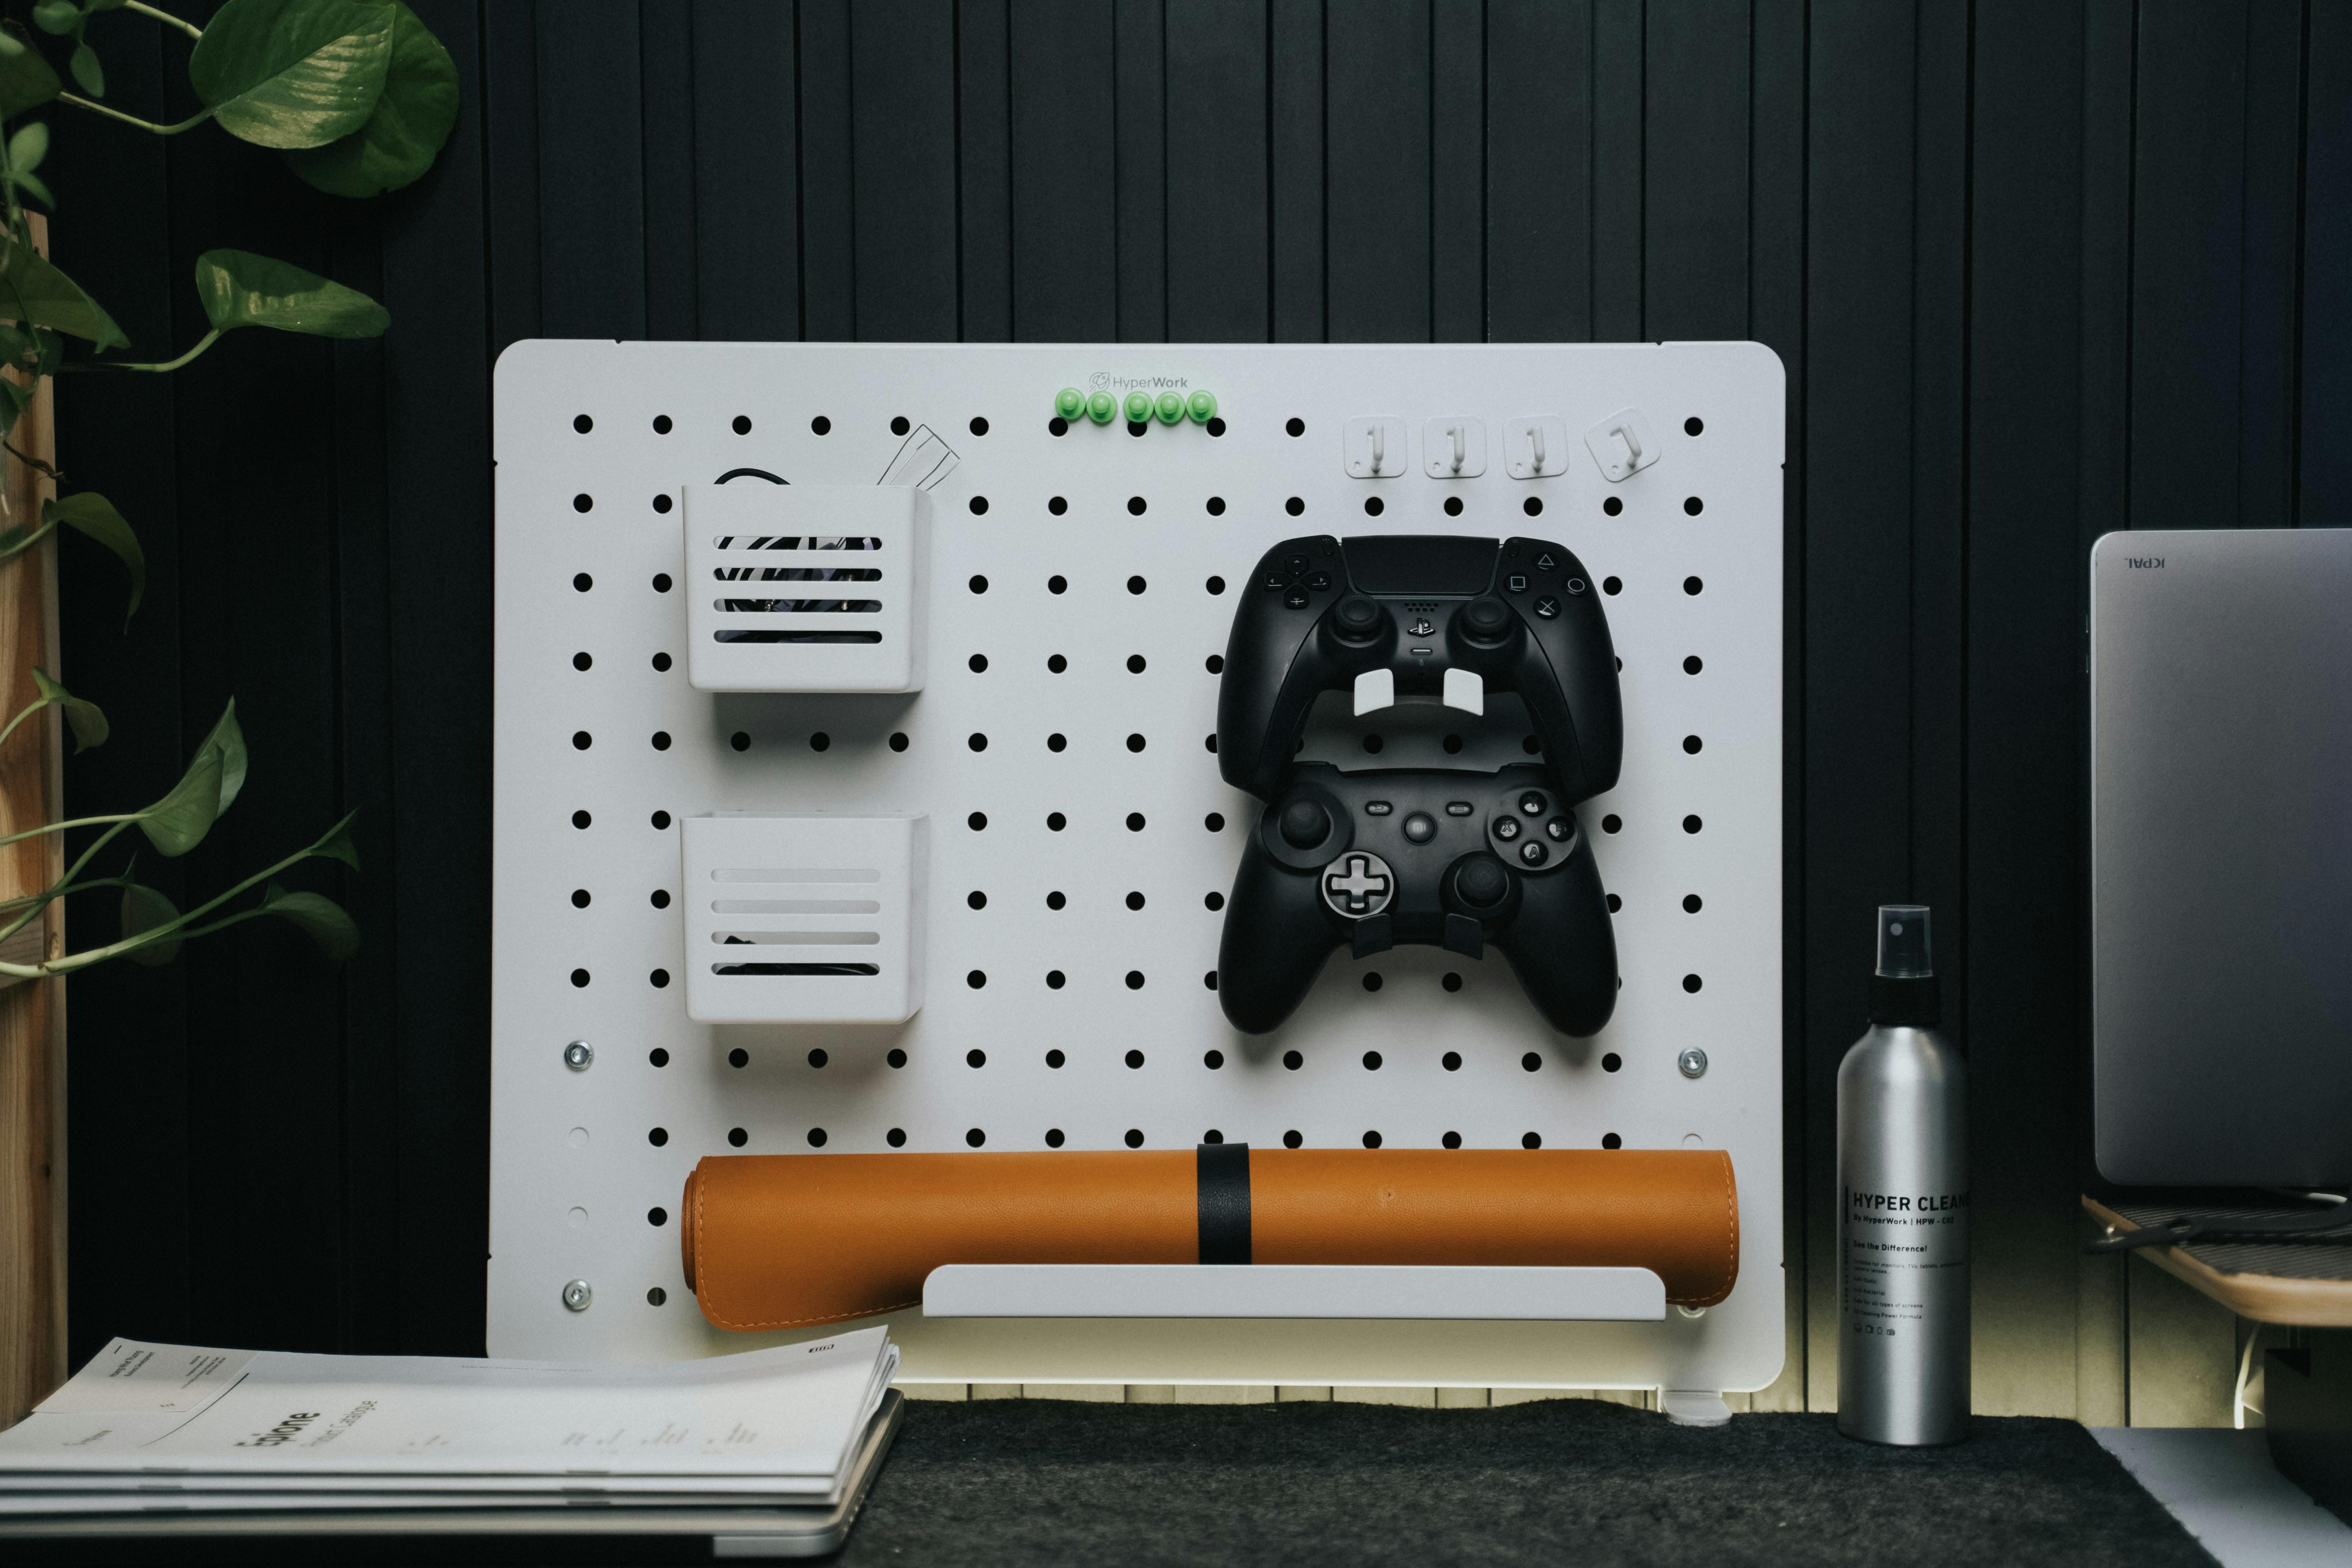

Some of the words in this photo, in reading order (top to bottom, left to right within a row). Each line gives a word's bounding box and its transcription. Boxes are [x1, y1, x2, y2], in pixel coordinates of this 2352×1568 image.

[1113, 377, 1188, 390] HyperWork
[2124, 558, 2165, 568] JCPAL
[1501, 821, 1512, 832] X
[1529, 846, 1541, 858] A
[1853, 1192, 1911, 1211] HYPER
[1853, 1213, 1861, 1222] By
[1863, 1216, 1907, 1225] HyperWork
[1853, 1240, 1865, 1249] See
[1867, 1242, 1879, 1250] the
[1882, 1244, 1927, 1252] Difference!
[329, 1400, 377, 1428] Catalogue
[234, 1412, 321, 1446] Epione
